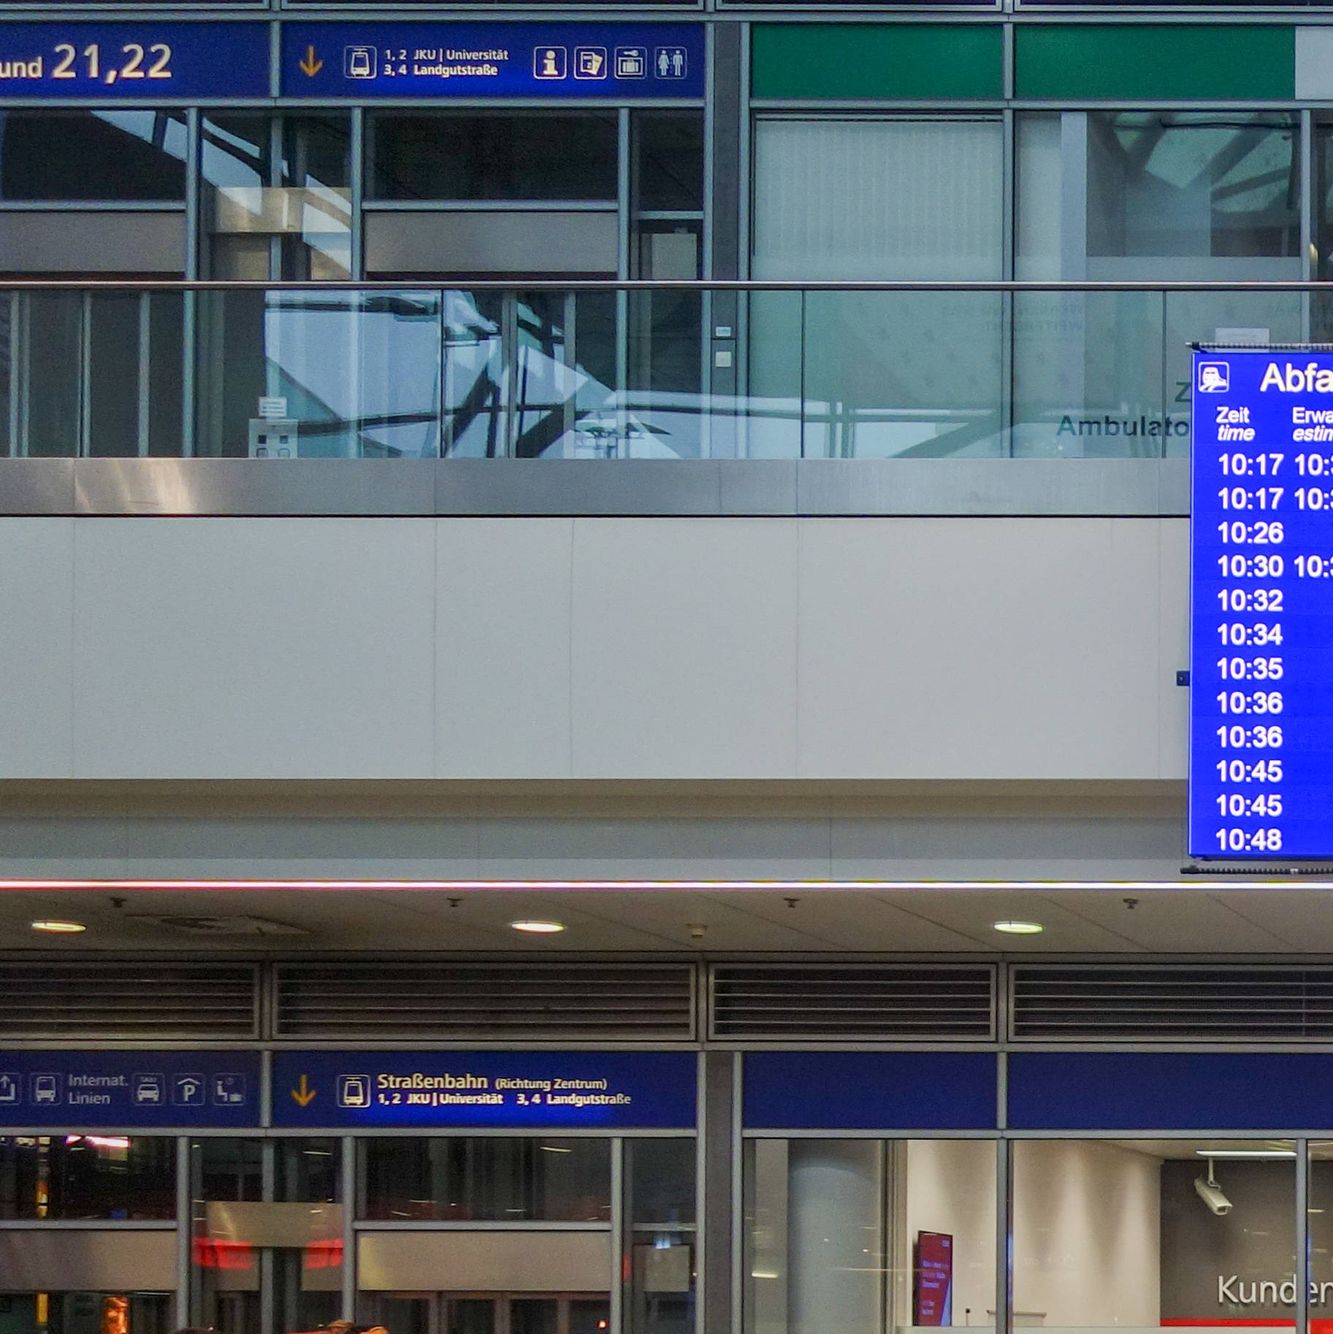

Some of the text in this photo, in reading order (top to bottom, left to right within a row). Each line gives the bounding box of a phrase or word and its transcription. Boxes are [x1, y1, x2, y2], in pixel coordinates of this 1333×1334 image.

[414, 50, 436, 59] JKU
[447, 49, 508, 60] Universität
[0, 44, 171, 83] und 21,22
[414, 64, 497, 78] Landgutstraße
[1216, 407, 1249, 423] Zeit
[1218, 424, 1255, 441] time
[1219, 454, 1284, 475] 10:17
[1218, 522, 1284, 544] 10:26
[1217, 658, 1283, 679] 10:35
[1217, 726, 1282, 748] 10:36
[69, 1074, 128, 1086] Internat.
[378, 1073, 607, 1091] Straßenbahn (Richtung Zentrum)
[69, 1092, 110, 1104] Linien
[407, 1094, 430, 1104] JKU
[440, 1093, 503, 1104] Universität
[547, 1093, 631, 1107] Landgutstraße
